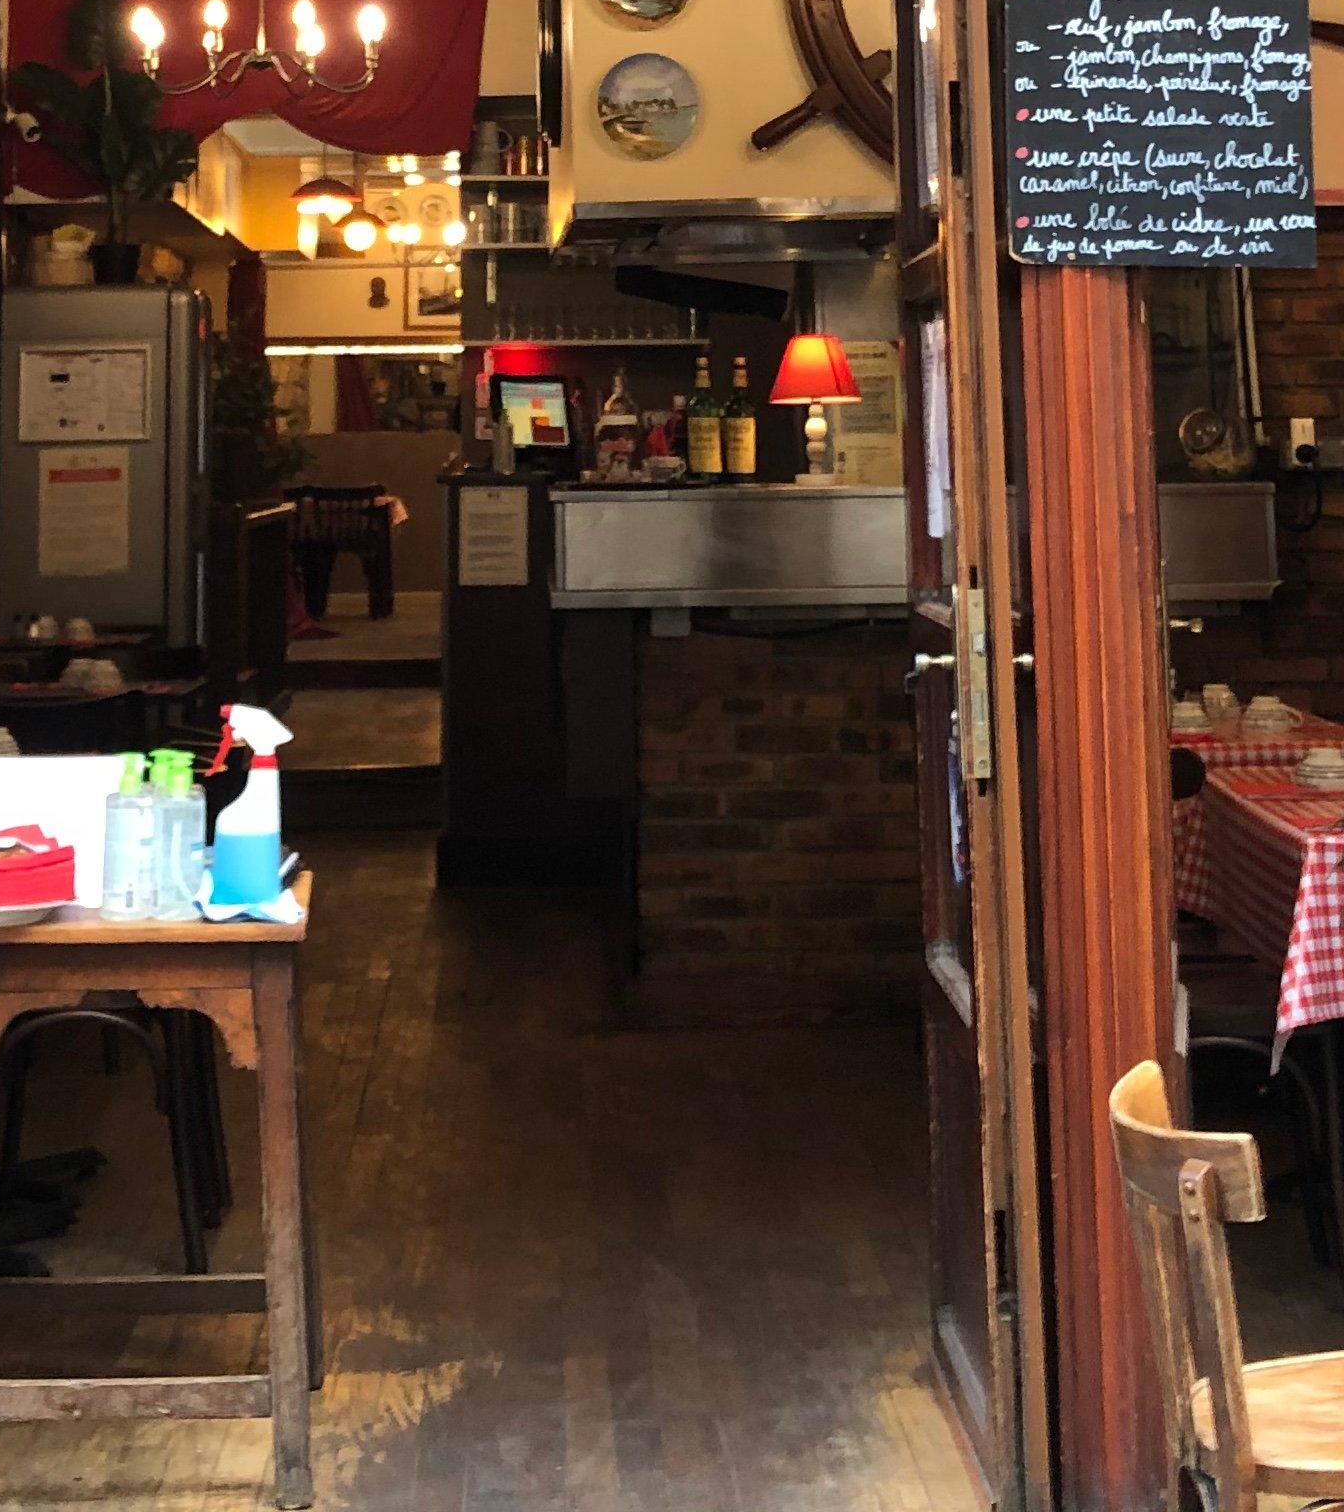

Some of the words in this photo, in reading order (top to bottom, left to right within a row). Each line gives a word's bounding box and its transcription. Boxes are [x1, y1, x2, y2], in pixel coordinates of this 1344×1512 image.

[1030, 106, 1078, 123] une
[1083, 101, 1138, 132] petite
[1142, 103, 1212, 126] salade
[1219, 102, 1275, 127] verte
[1027, 146, 1078, 168] une
[1078, 140, 1141, 177] crêpe
[1033, 213, 1078, 230] une
[1138, 213, 1169, 233] de
